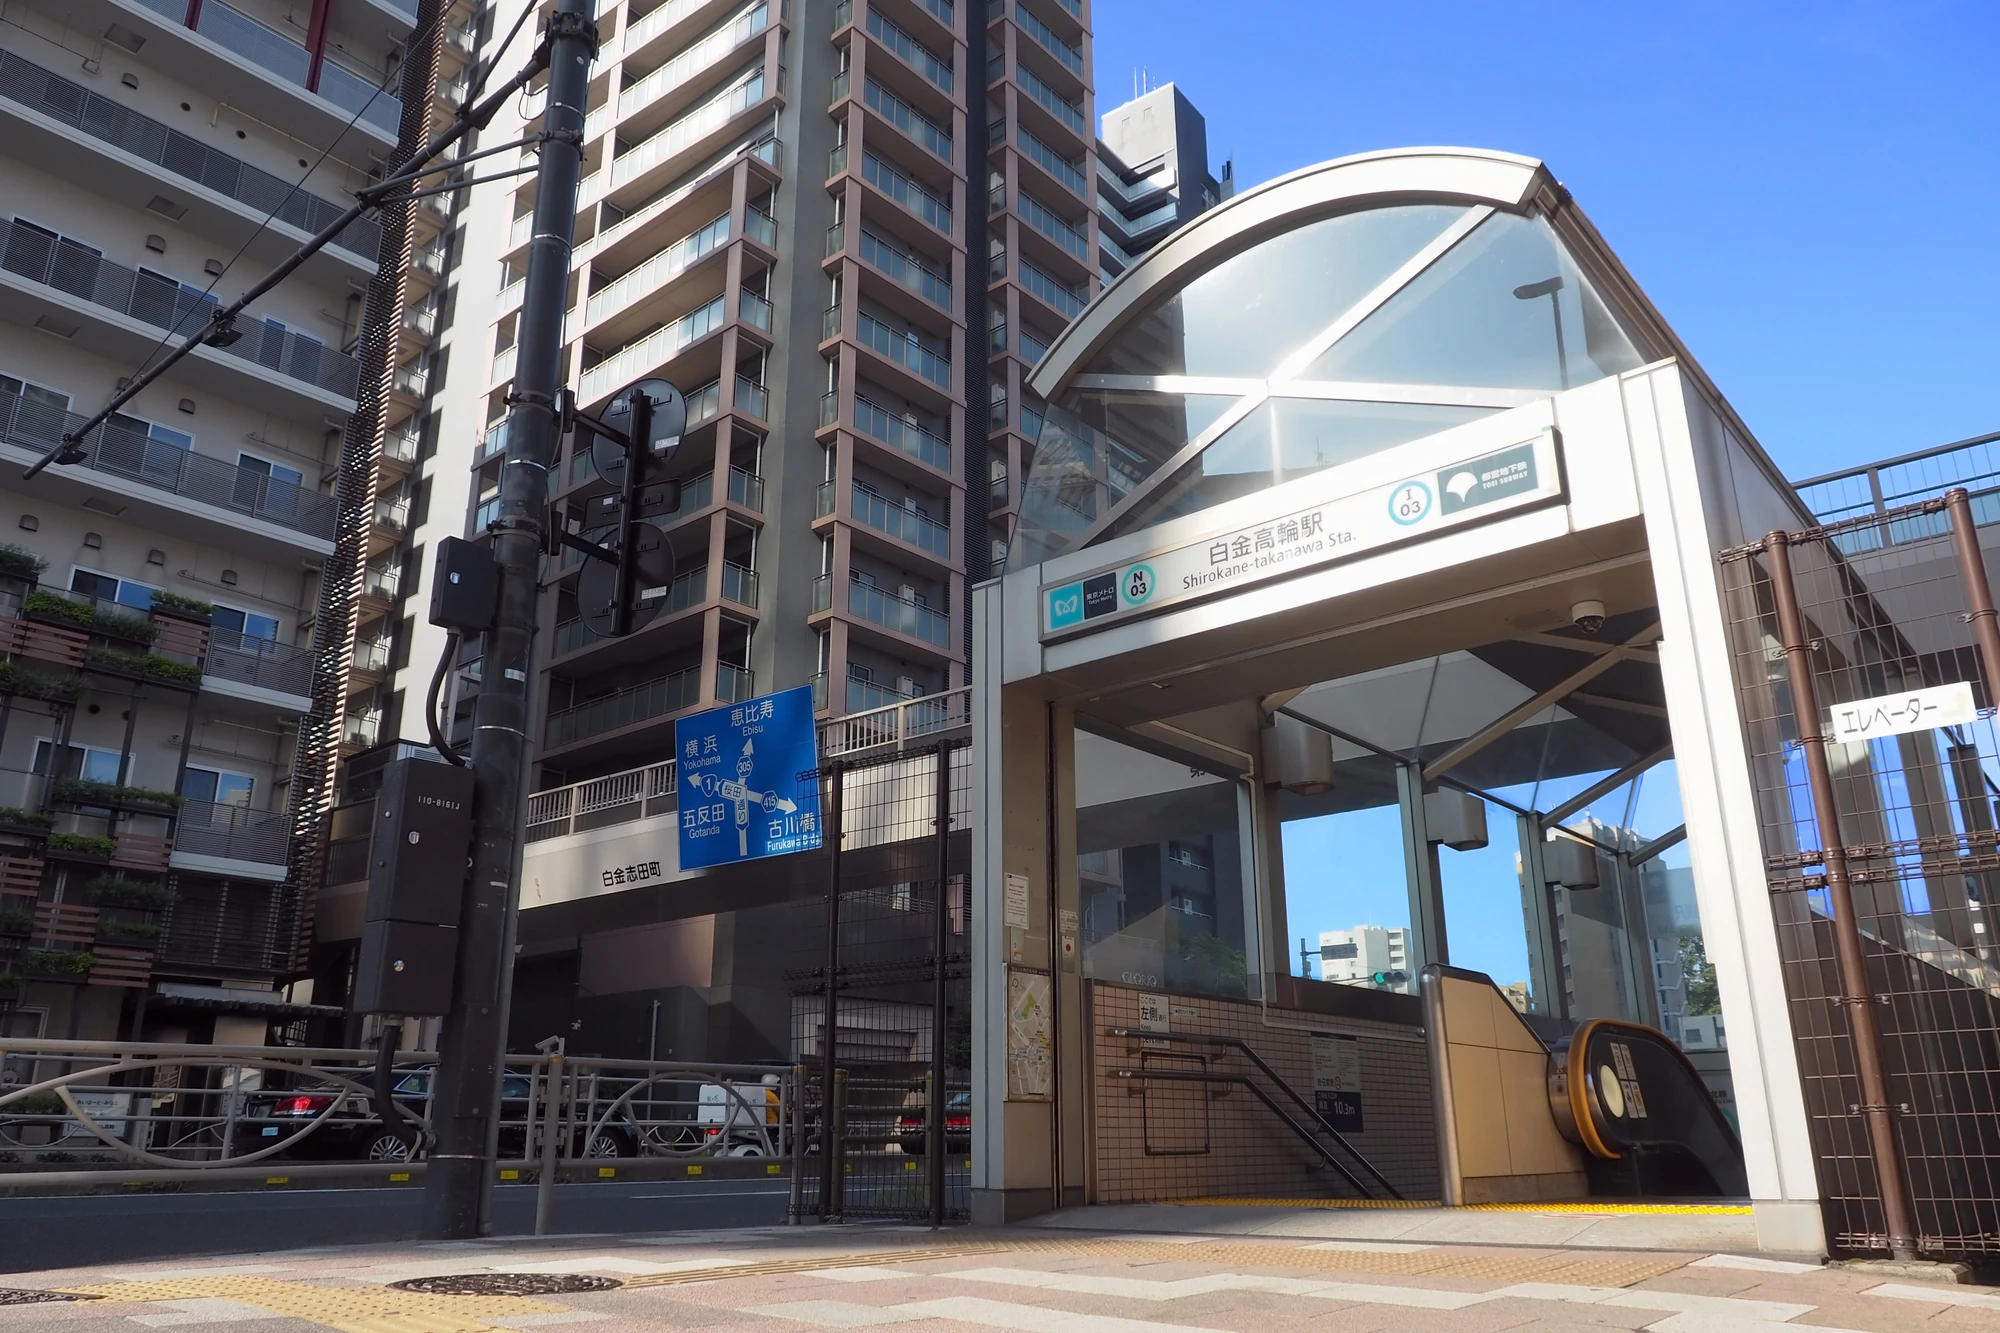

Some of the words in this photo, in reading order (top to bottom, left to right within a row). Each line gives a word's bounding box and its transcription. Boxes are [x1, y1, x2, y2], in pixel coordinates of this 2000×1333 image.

[1483, 479, 1498, 489] TOEI
[1500, 470, 1528, 485] SUBWAY
[1400, 500, 1421, 517] 03
[1209, 511, 1324, 566] 白金高輪駅
[1183, 540, 1323, 590] Shirokane-takanawa
[1329, 531, 1357, 548] Sta.
[1133, 571, 1143, 583] N
[1086, 586, 1114, 600] 東京メトロ
[1130, 582, 1147, 597] 03
[1100, 594, 1113, 602] Metro
[731, 699, 774, 727] 恵比寿
[1841, 698, 1938, 734] エレベーター
[742, 724, 764, 737] Ebisu
[685, 734, 718, 758] 横浜
[683, 755, 721, 770] Yokohama
[738, 760, 751, 772] 305
[705, 779, 711, 791] 1
[763, 795, 776, 808] 415
[683, 803, 725, 829] 五反田
[688, 825, 721, 839] Gotanda
[768, 812, 815, 839] 古川橋
[767, 838, 801, 852] Furukawa
[602, 861, 661, 887] 白金志田町
[1333, 1101, 1356, 1116] 10.3m
